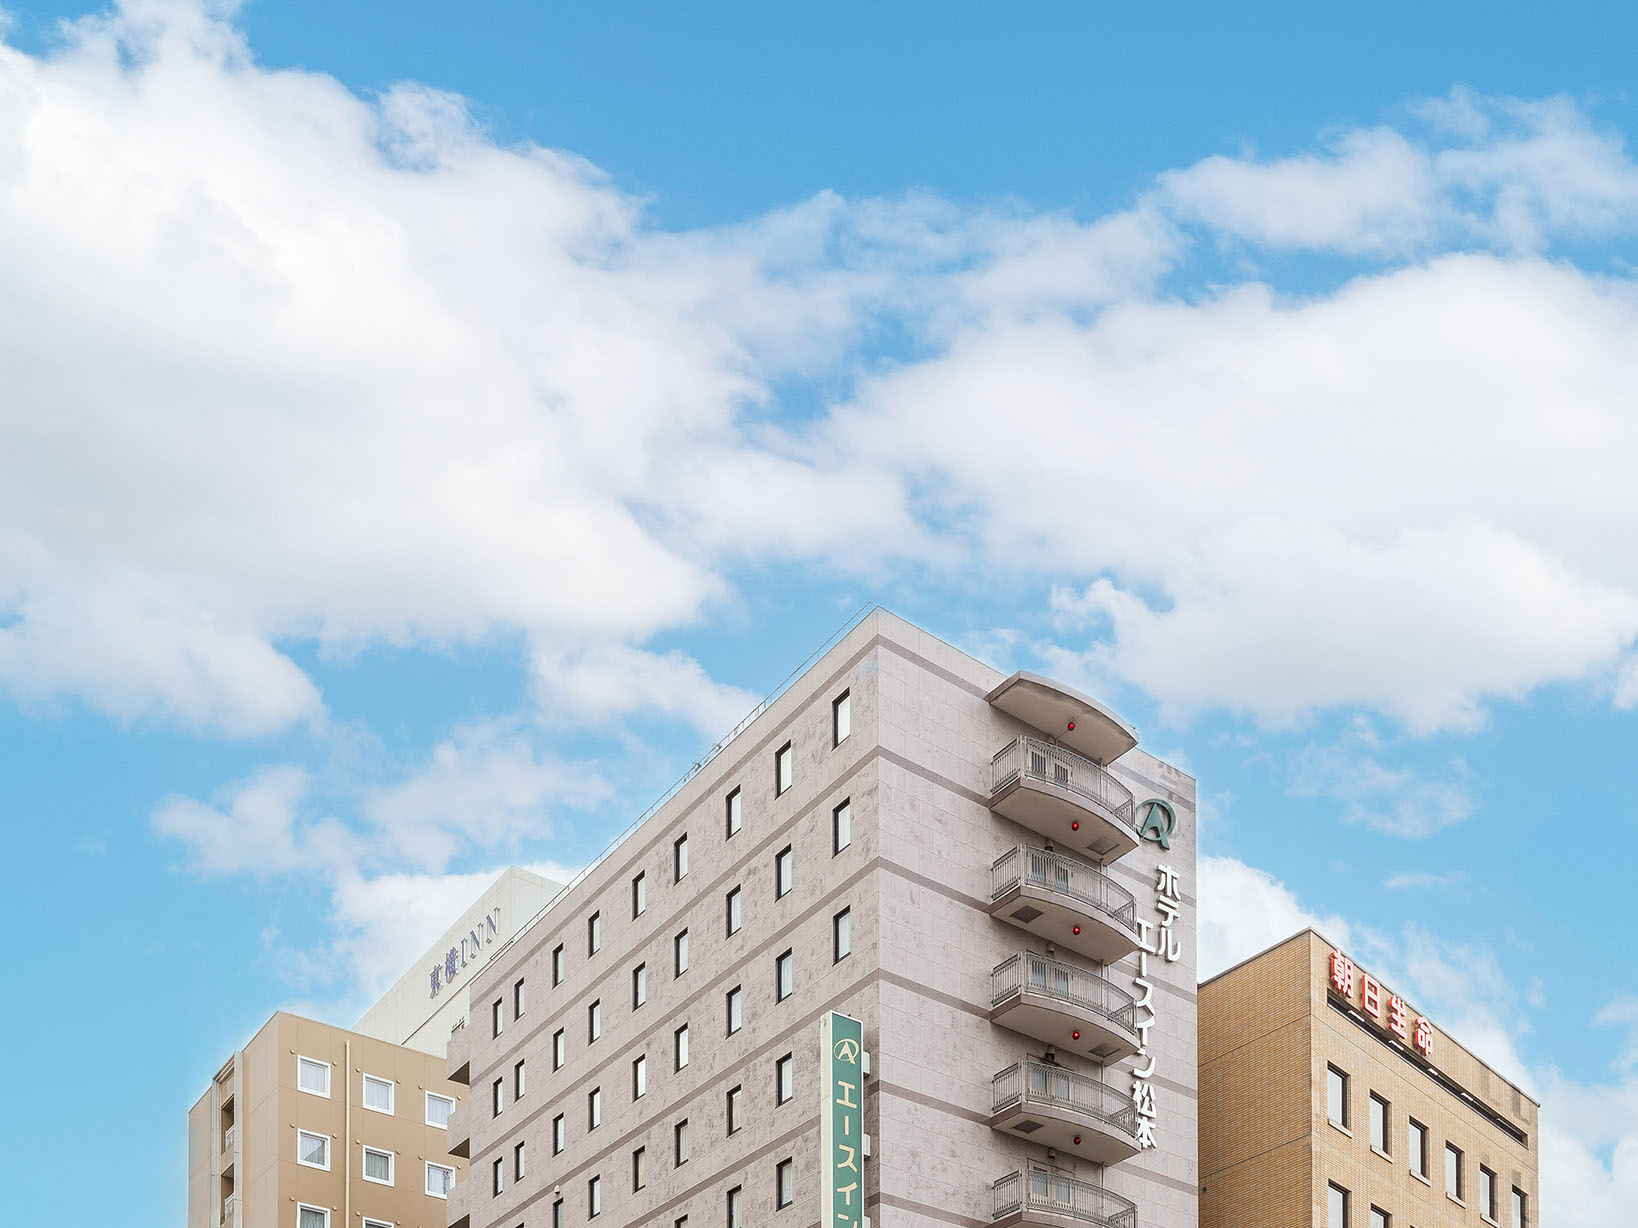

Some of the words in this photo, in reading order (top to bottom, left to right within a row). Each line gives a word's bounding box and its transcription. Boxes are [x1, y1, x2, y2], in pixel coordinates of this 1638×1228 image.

[429, 906, 500, 1000] 東横INN
[1156, 864, 1182, 962] ホテル
[1331, 949, 1434, 1057] 朝日生命
